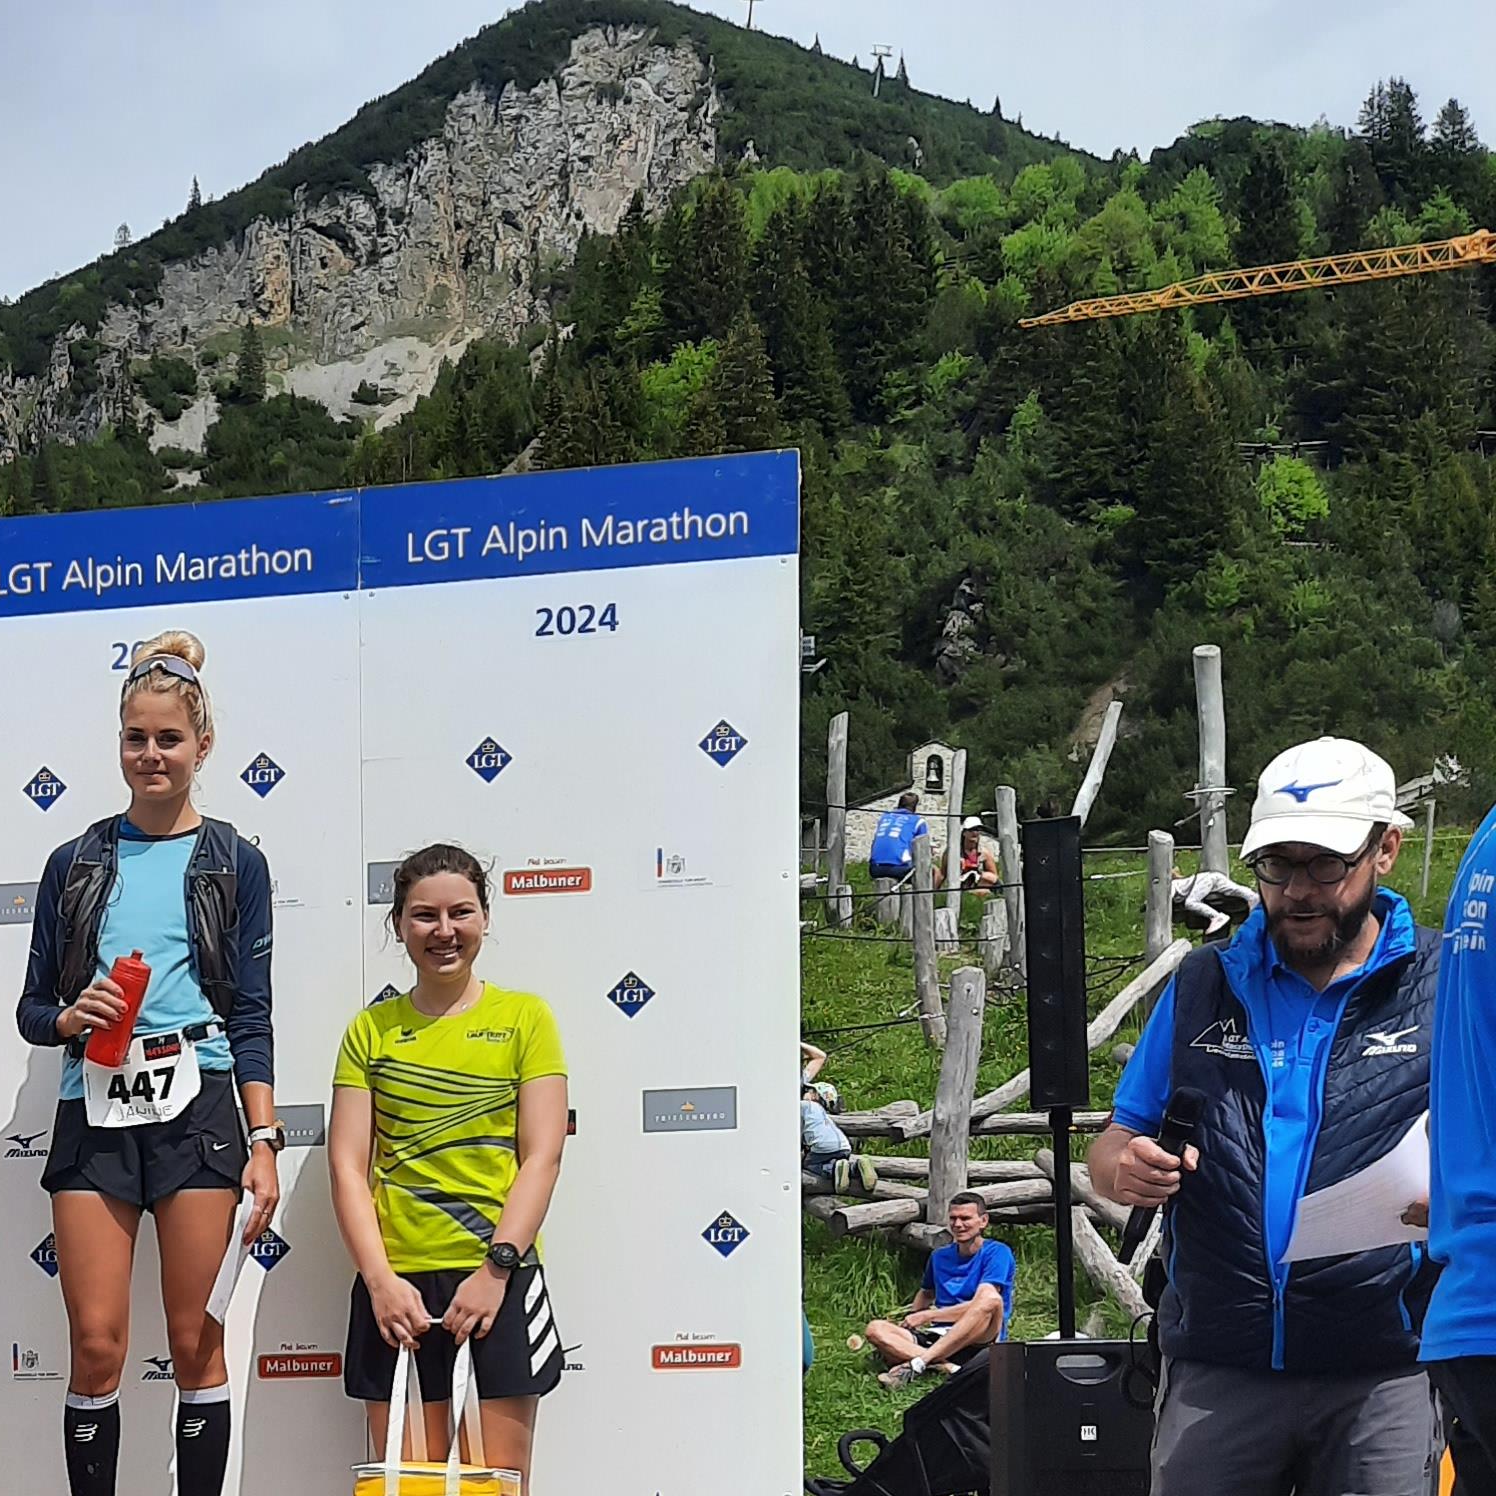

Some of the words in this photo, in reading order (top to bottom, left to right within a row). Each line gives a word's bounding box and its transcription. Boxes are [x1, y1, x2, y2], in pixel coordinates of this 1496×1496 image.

[406, 526, 472, 564] LGT
[481, 520, 568, 561] Alpin
[581, 506, 749, 549] Marathon
[61, 554, 144, 597] Alpin
[155, 543, 313, 585] Marathon
[534, 602, 620, 637] 2024
[706, 736, 741, 754] LGT
[473, 751, 506, 769] LGT
[247, 767, 280, 784] LGT
[30, 780, 63, 798] LGT
[510, 874, 583, 889] Malbuner
[615, 988, 648, 1004] LGT
[107, 1066, 176, 1105] 447
[710, 1228, 743, 1243] LGT
[254, 1243, 284, 1257] LGT
[660, 1350, 732, 1364] Malbuner
[266, 1359, 333, 1373] Malbuner
